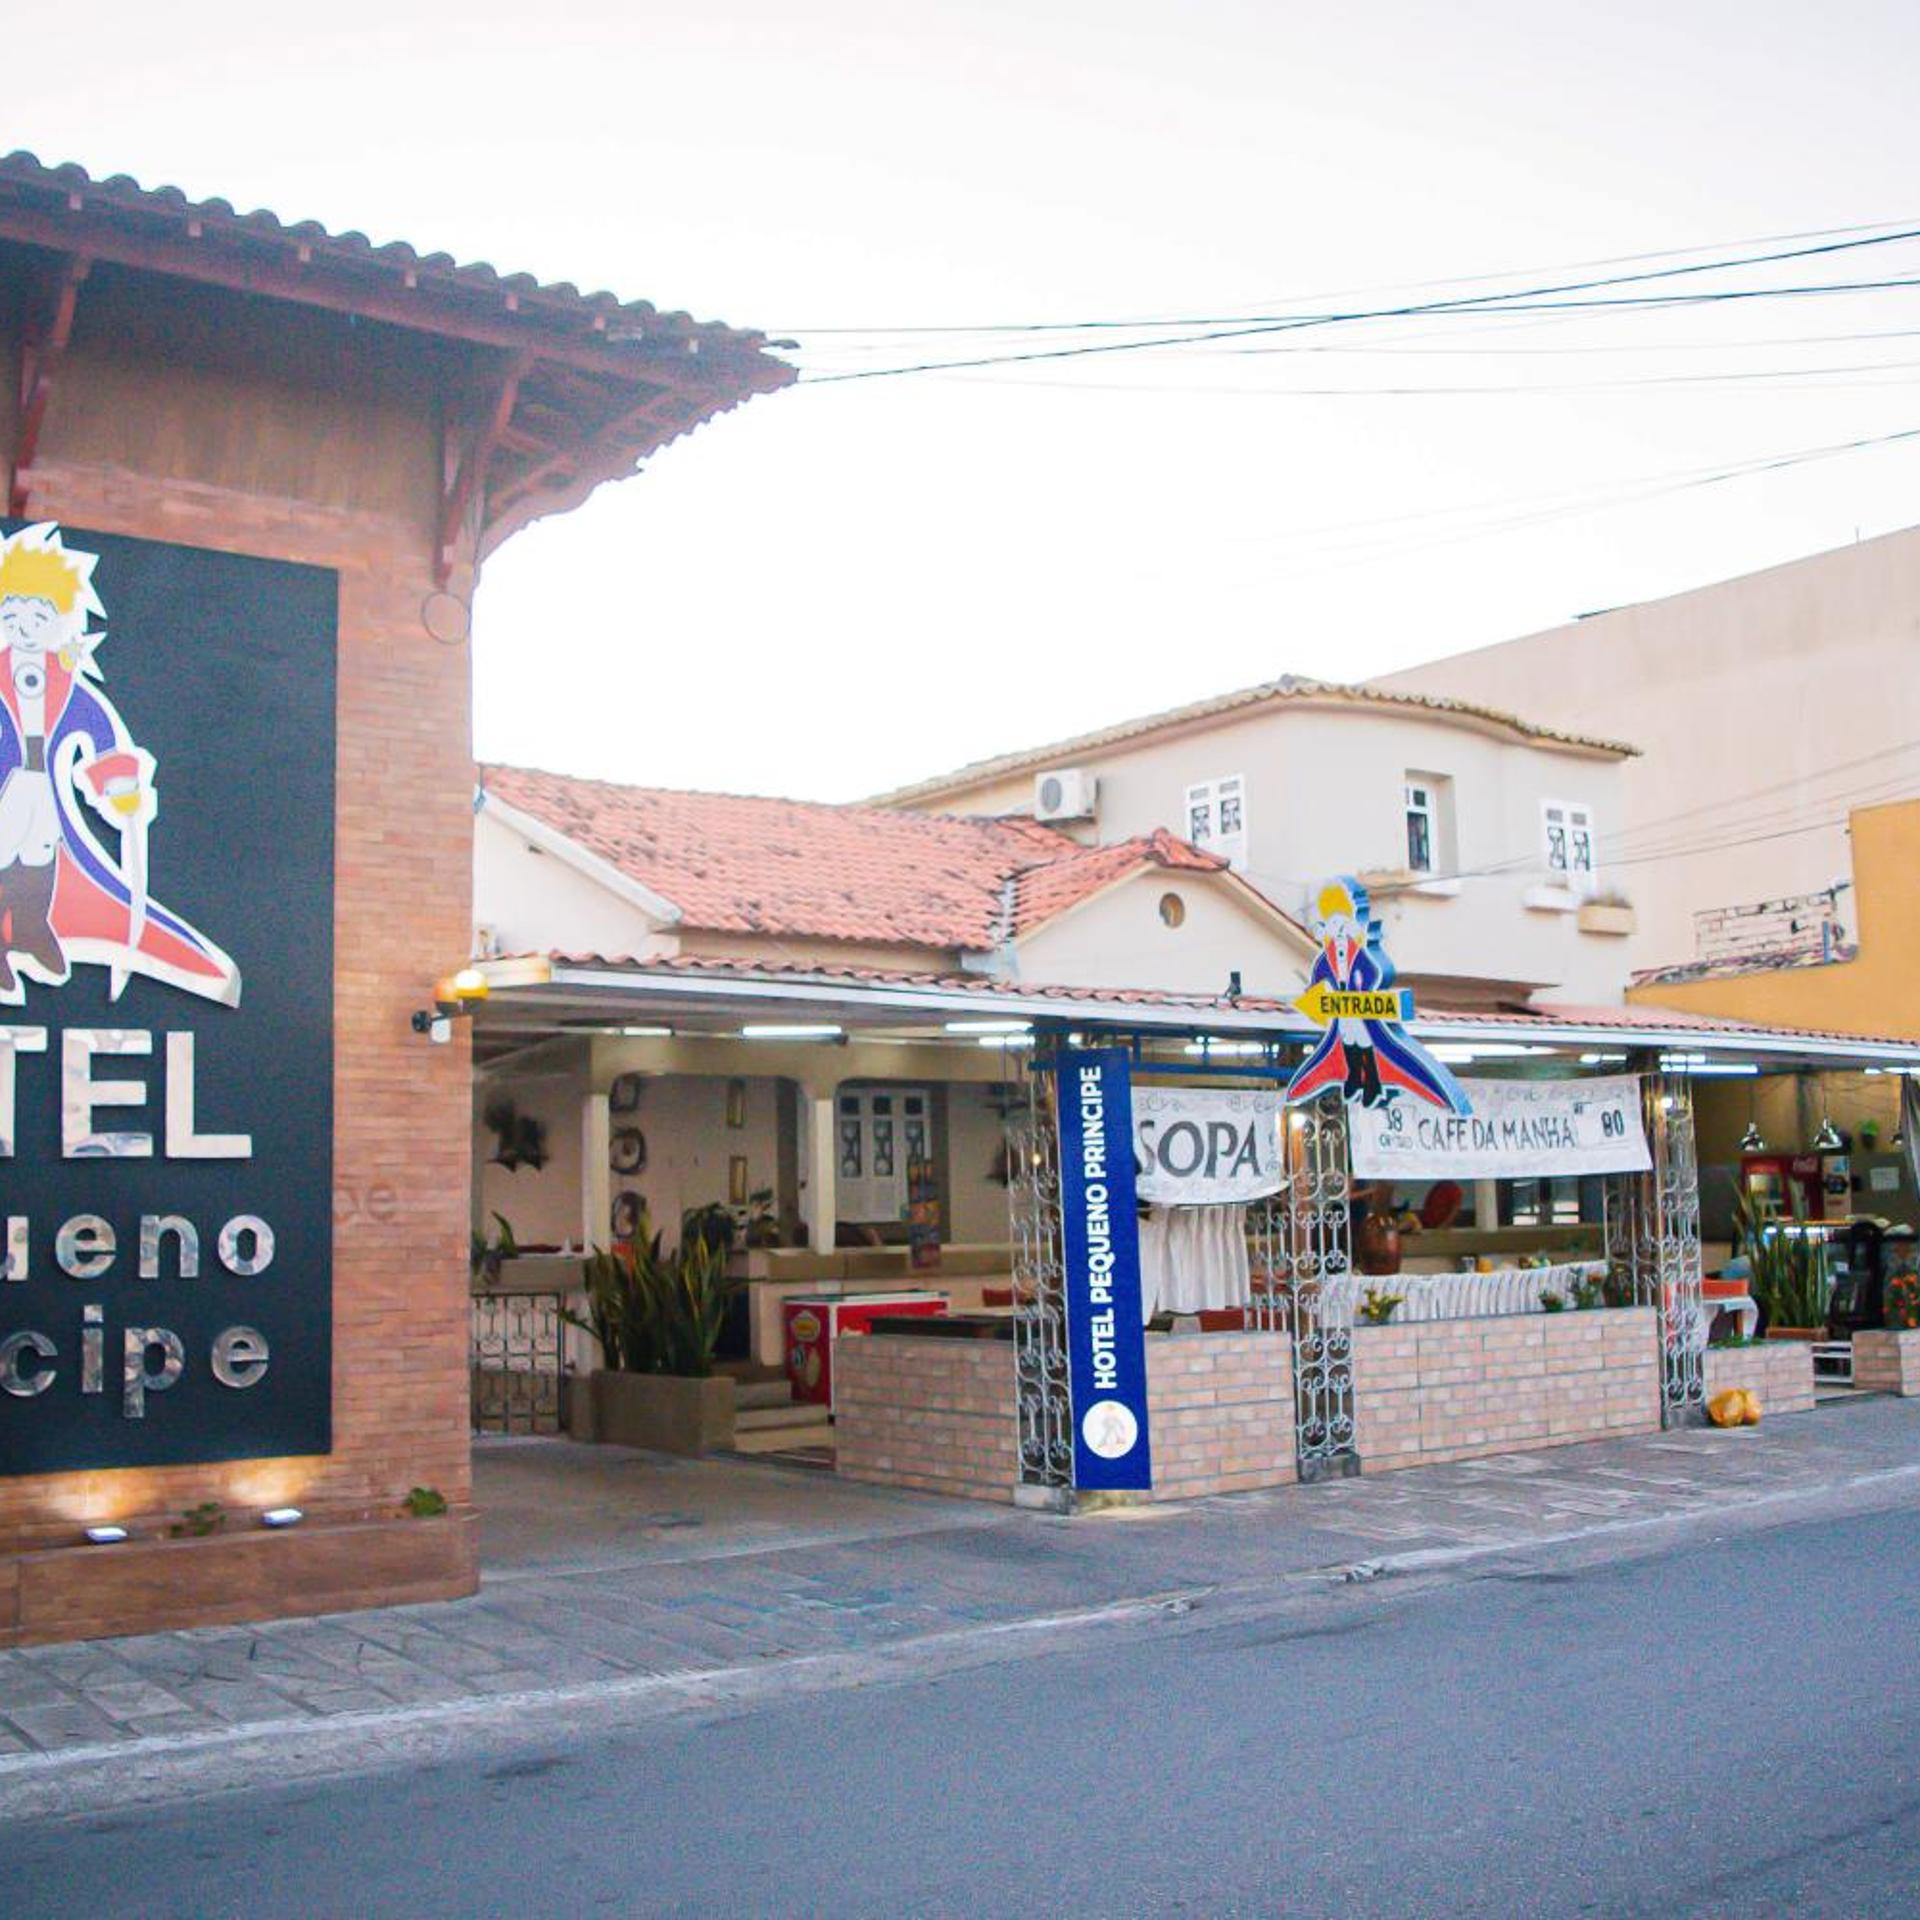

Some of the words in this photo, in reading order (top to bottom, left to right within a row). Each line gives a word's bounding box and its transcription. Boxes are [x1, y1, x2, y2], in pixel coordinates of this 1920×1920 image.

[1320, 996, 1396, 1015] ENTRADA
[1139, 1120, 1263, 1178] SOPA
[1471, 1118, 1499, 1151] DA
[1601, 1109, 1625, 1138] 80
[1085, 1184, 1115, 1304] PEQUENO
[0, 1304, 269, 1418] cipe
[1090, 1308, 1118, 1389] HOTEL
